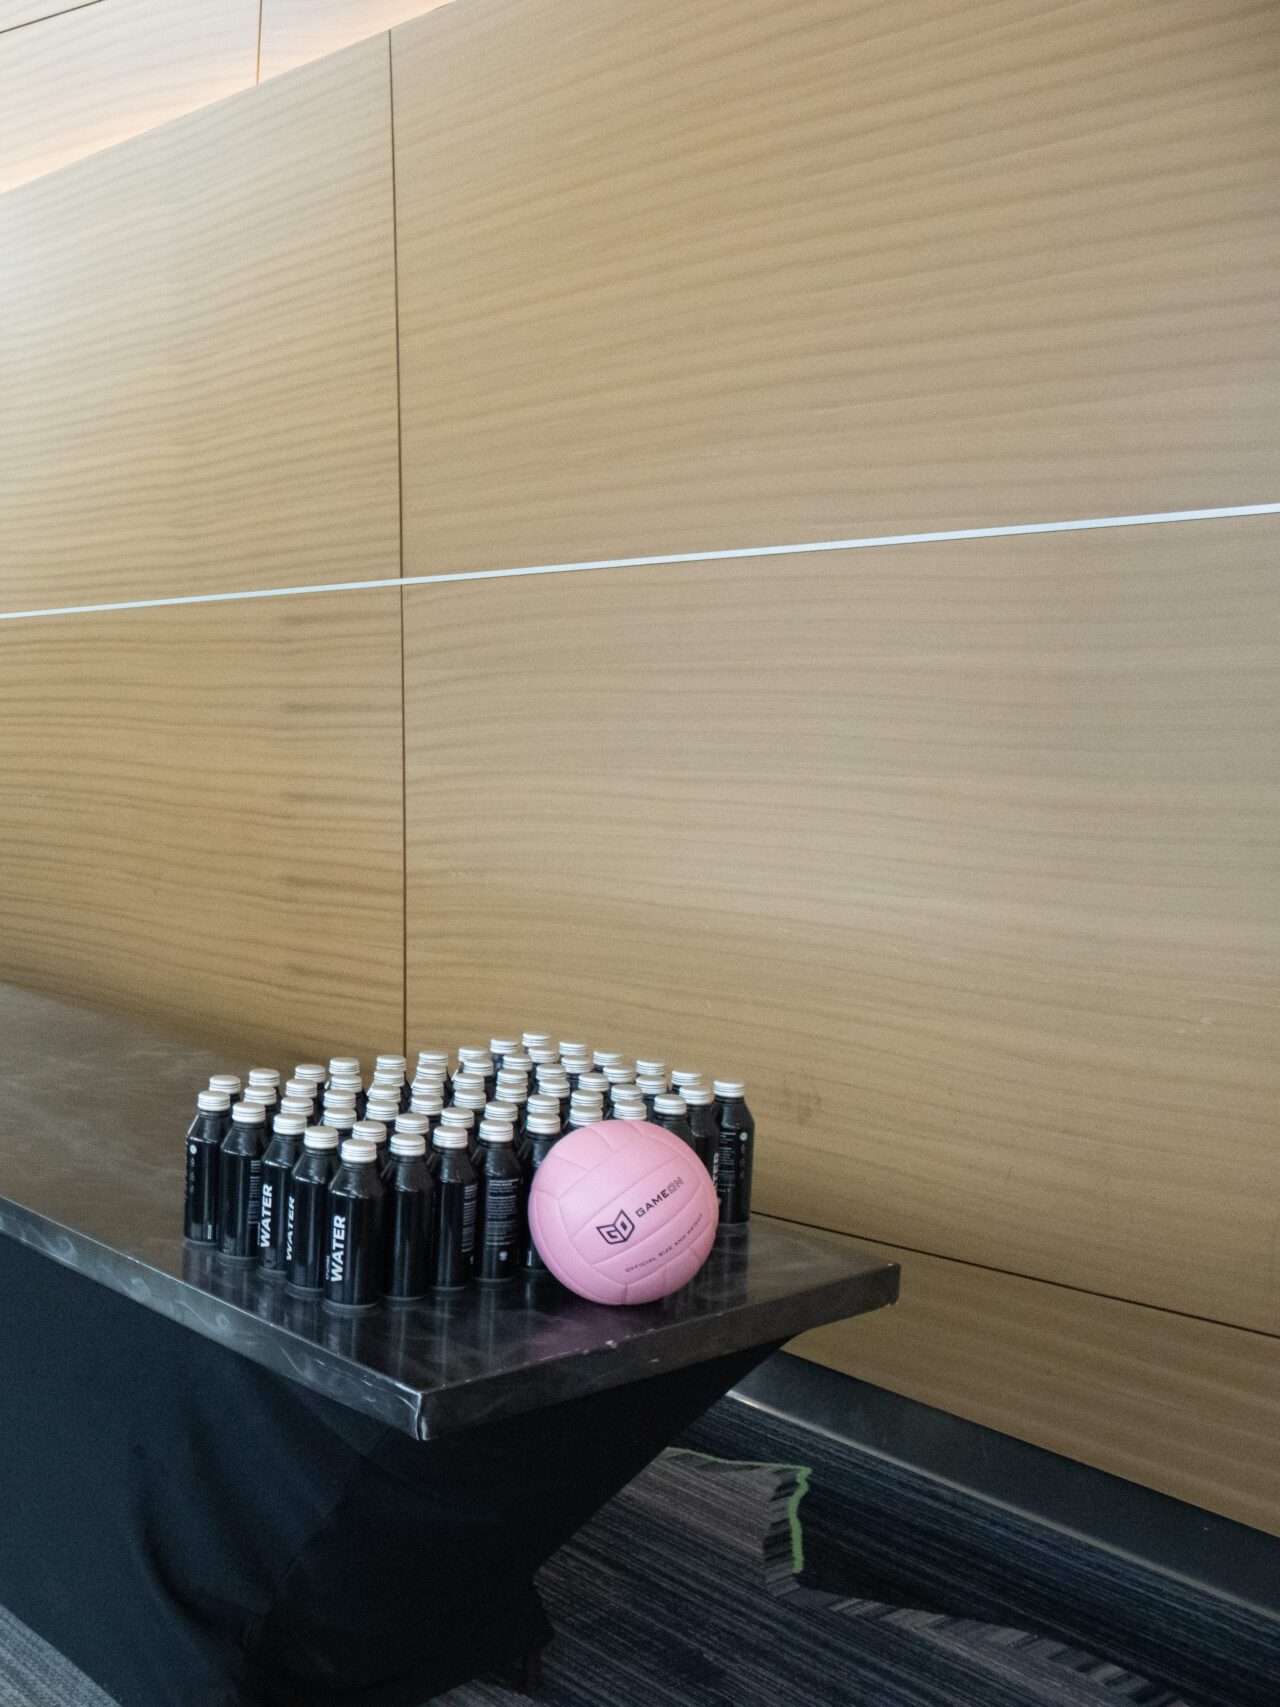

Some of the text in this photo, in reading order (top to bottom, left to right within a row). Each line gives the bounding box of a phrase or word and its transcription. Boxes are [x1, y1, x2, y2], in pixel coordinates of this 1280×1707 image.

[260, 1183, 273, 1248] WATER
[286, 1196, 295, 1261] WATER
[635, 1177, 685, 1218] GAMEON
[330, 1215, 346, 1283] WATER
[674, 1234, 687, 1246] AND
